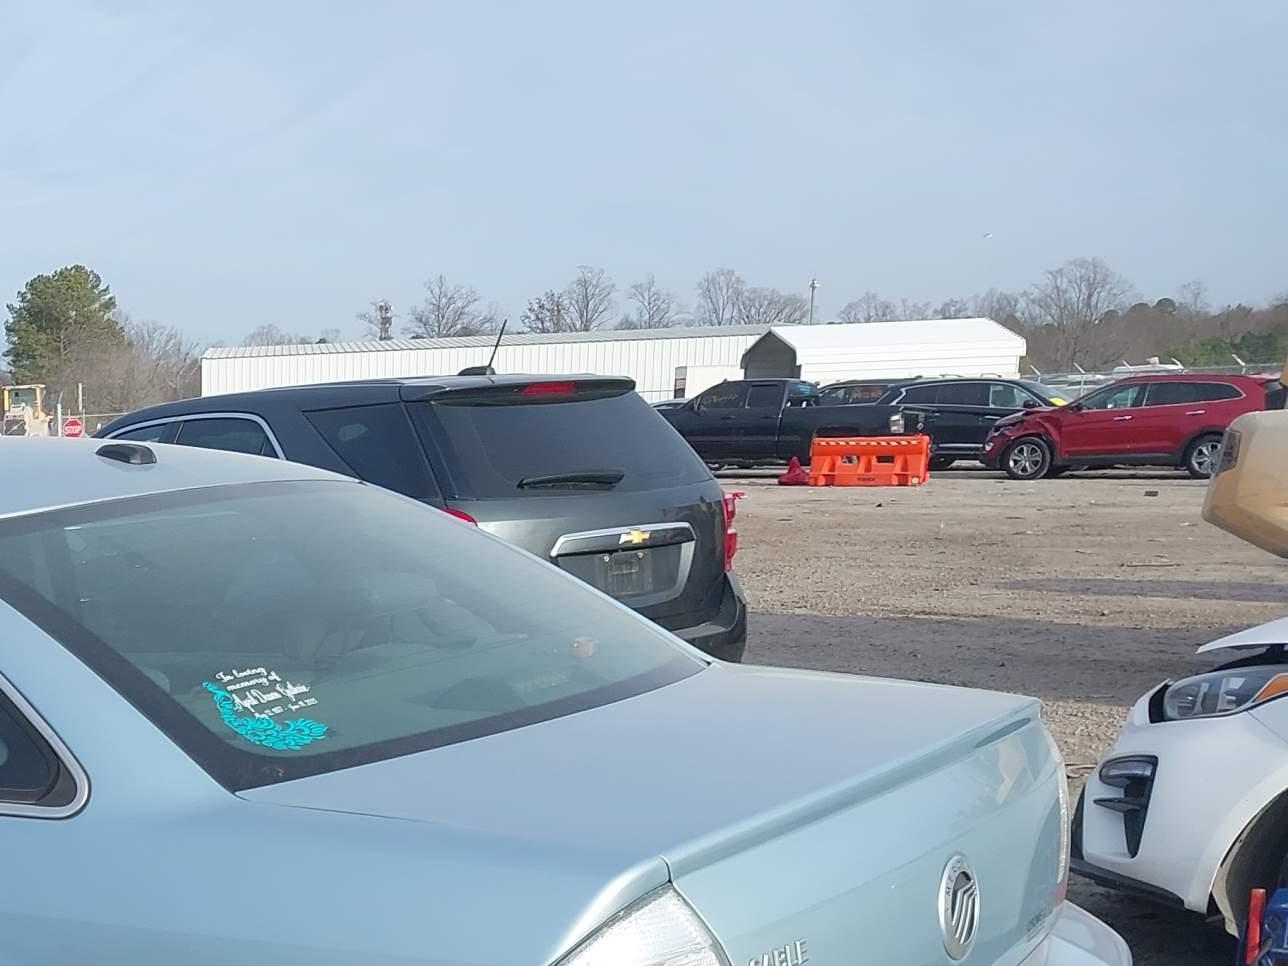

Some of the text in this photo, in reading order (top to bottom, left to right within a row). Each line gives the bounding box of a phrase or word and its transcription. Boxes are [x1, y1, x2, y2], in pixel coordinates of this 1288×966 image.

[65, 425, 82, 435] STOP
[232, 667, 267, 678] loving
[226, 671, 281, 691] memory of
